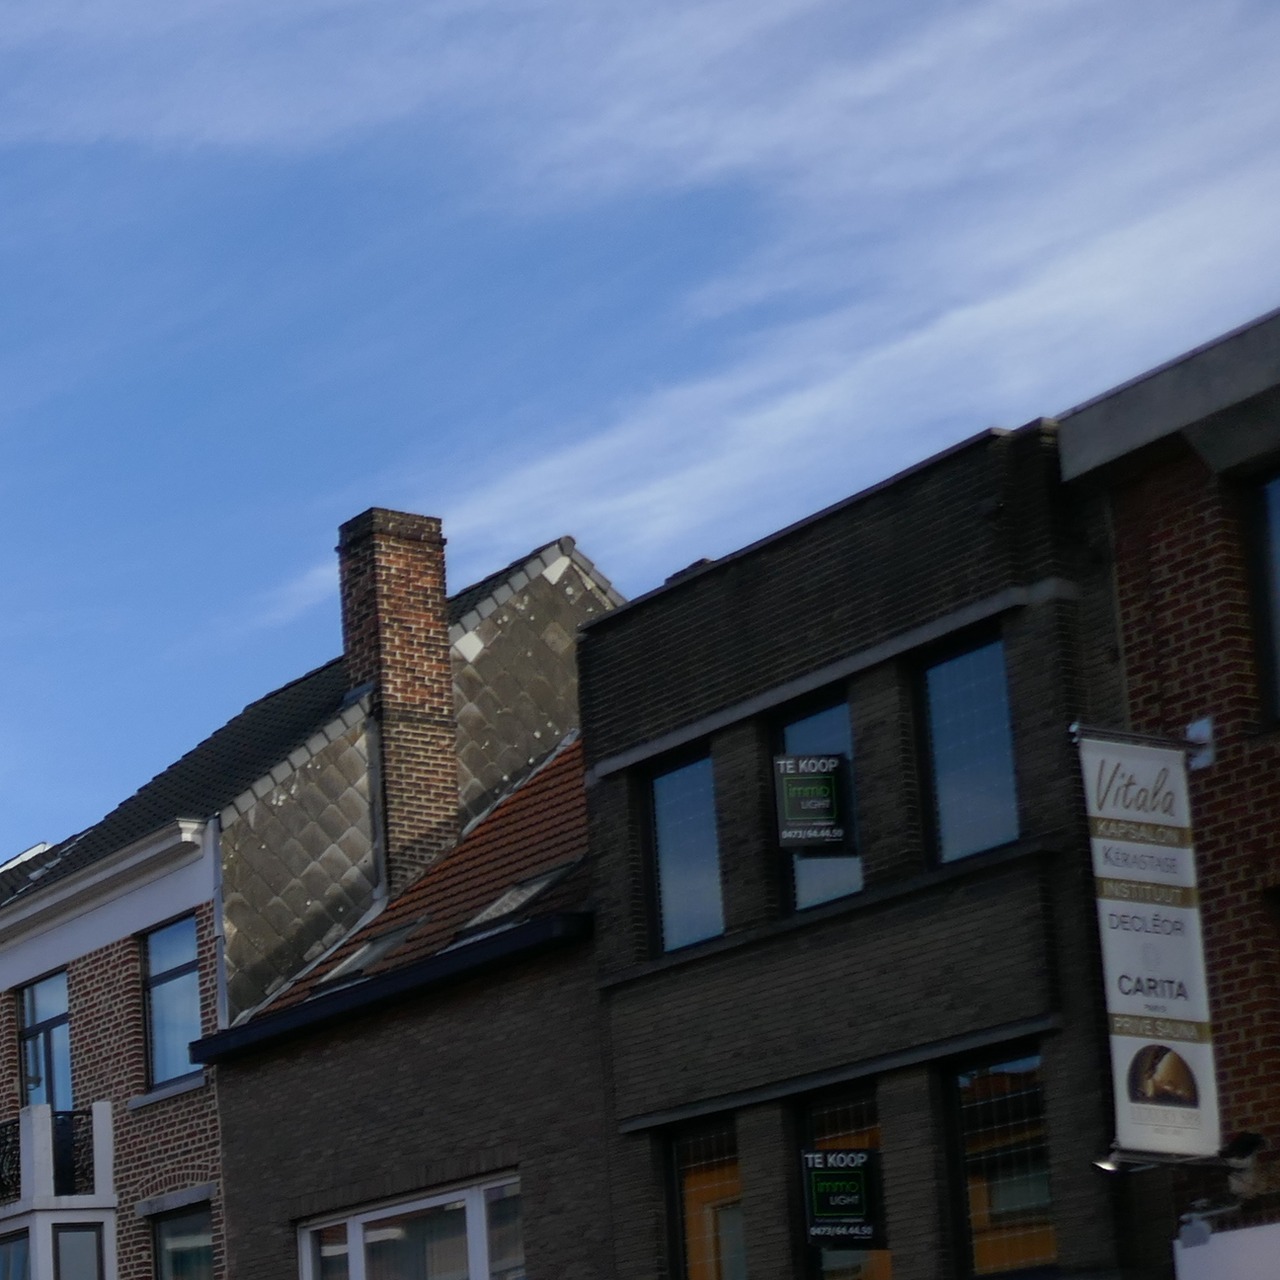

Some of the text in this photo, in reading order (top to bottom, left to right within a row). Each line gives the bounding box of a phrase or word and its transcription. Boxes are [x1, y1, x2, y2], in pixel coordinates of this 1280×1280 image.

[776, 758, 840, 774] TE KOOP
[1096, 759, 1176, 817] Vitala
[1118, 974, 1189, 1000] CARITA
[804, 1153, 868, 1168] TE KOOP
